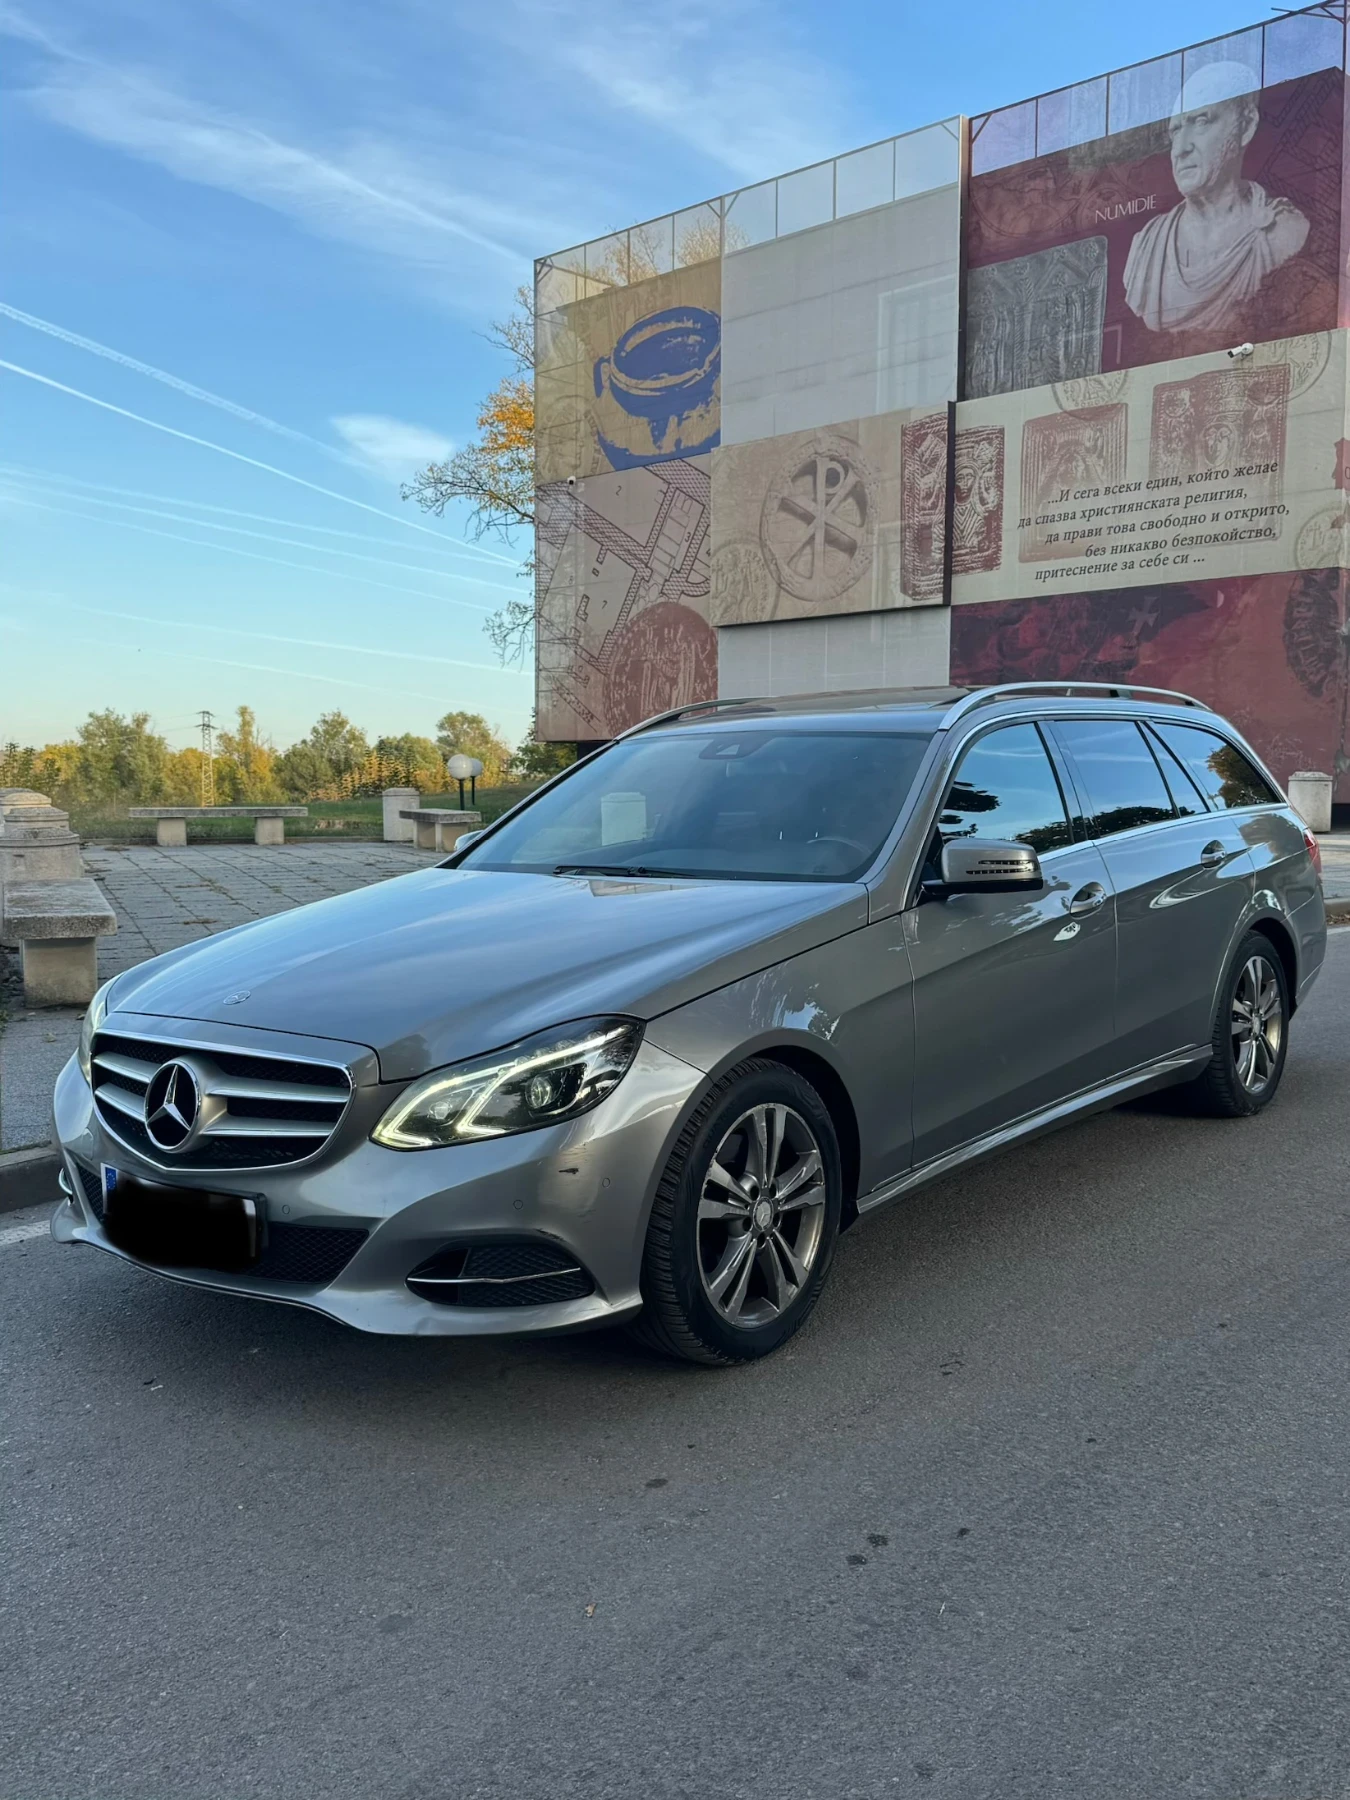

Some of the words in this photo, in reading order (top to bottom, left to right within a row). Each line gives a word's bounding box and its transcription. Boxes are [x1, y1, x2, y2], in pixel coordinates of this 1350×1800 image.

[1096, 194, 1156, 223] NUMIDIE
[1073, 488, 1100, 501] сега
[1103, 481, 1141, 496] всеки
[1146, 475, 1182, 491] един,
[1187, 468, 1229, 484] който
[1233, 461, 1278, 478] желае
[1017, 516, 1031, 529] да
[1035, 511, 1076, 525] спазва
[1080, 496, 1180, 521] християнската
[1184, 487, 1247, 508] религия,
[684, 531, 692, 543] 3
[1045, 532, 1059, 545] да
[1063, 527, 1102, 543] прави
[1107, 522, 1136, 534] това
[1140, 514, 1206, 532] свободно
[1210, 512, 1220, 522] и
[1224, 503, 1290, 521] открито,
[1085, 544, 1107, 558] без
[1110, 539, 1168, 555] никакво
[1171, 526, 1276, 548] безпокойство,
[1035, 560, 1118, 582] притеснение
[1121, 559, 1135, 570] за
[1139, 553, 1169, 568] себе
[1173, 553, 1189, 564] си
[601, 600, 608, 609] 7
